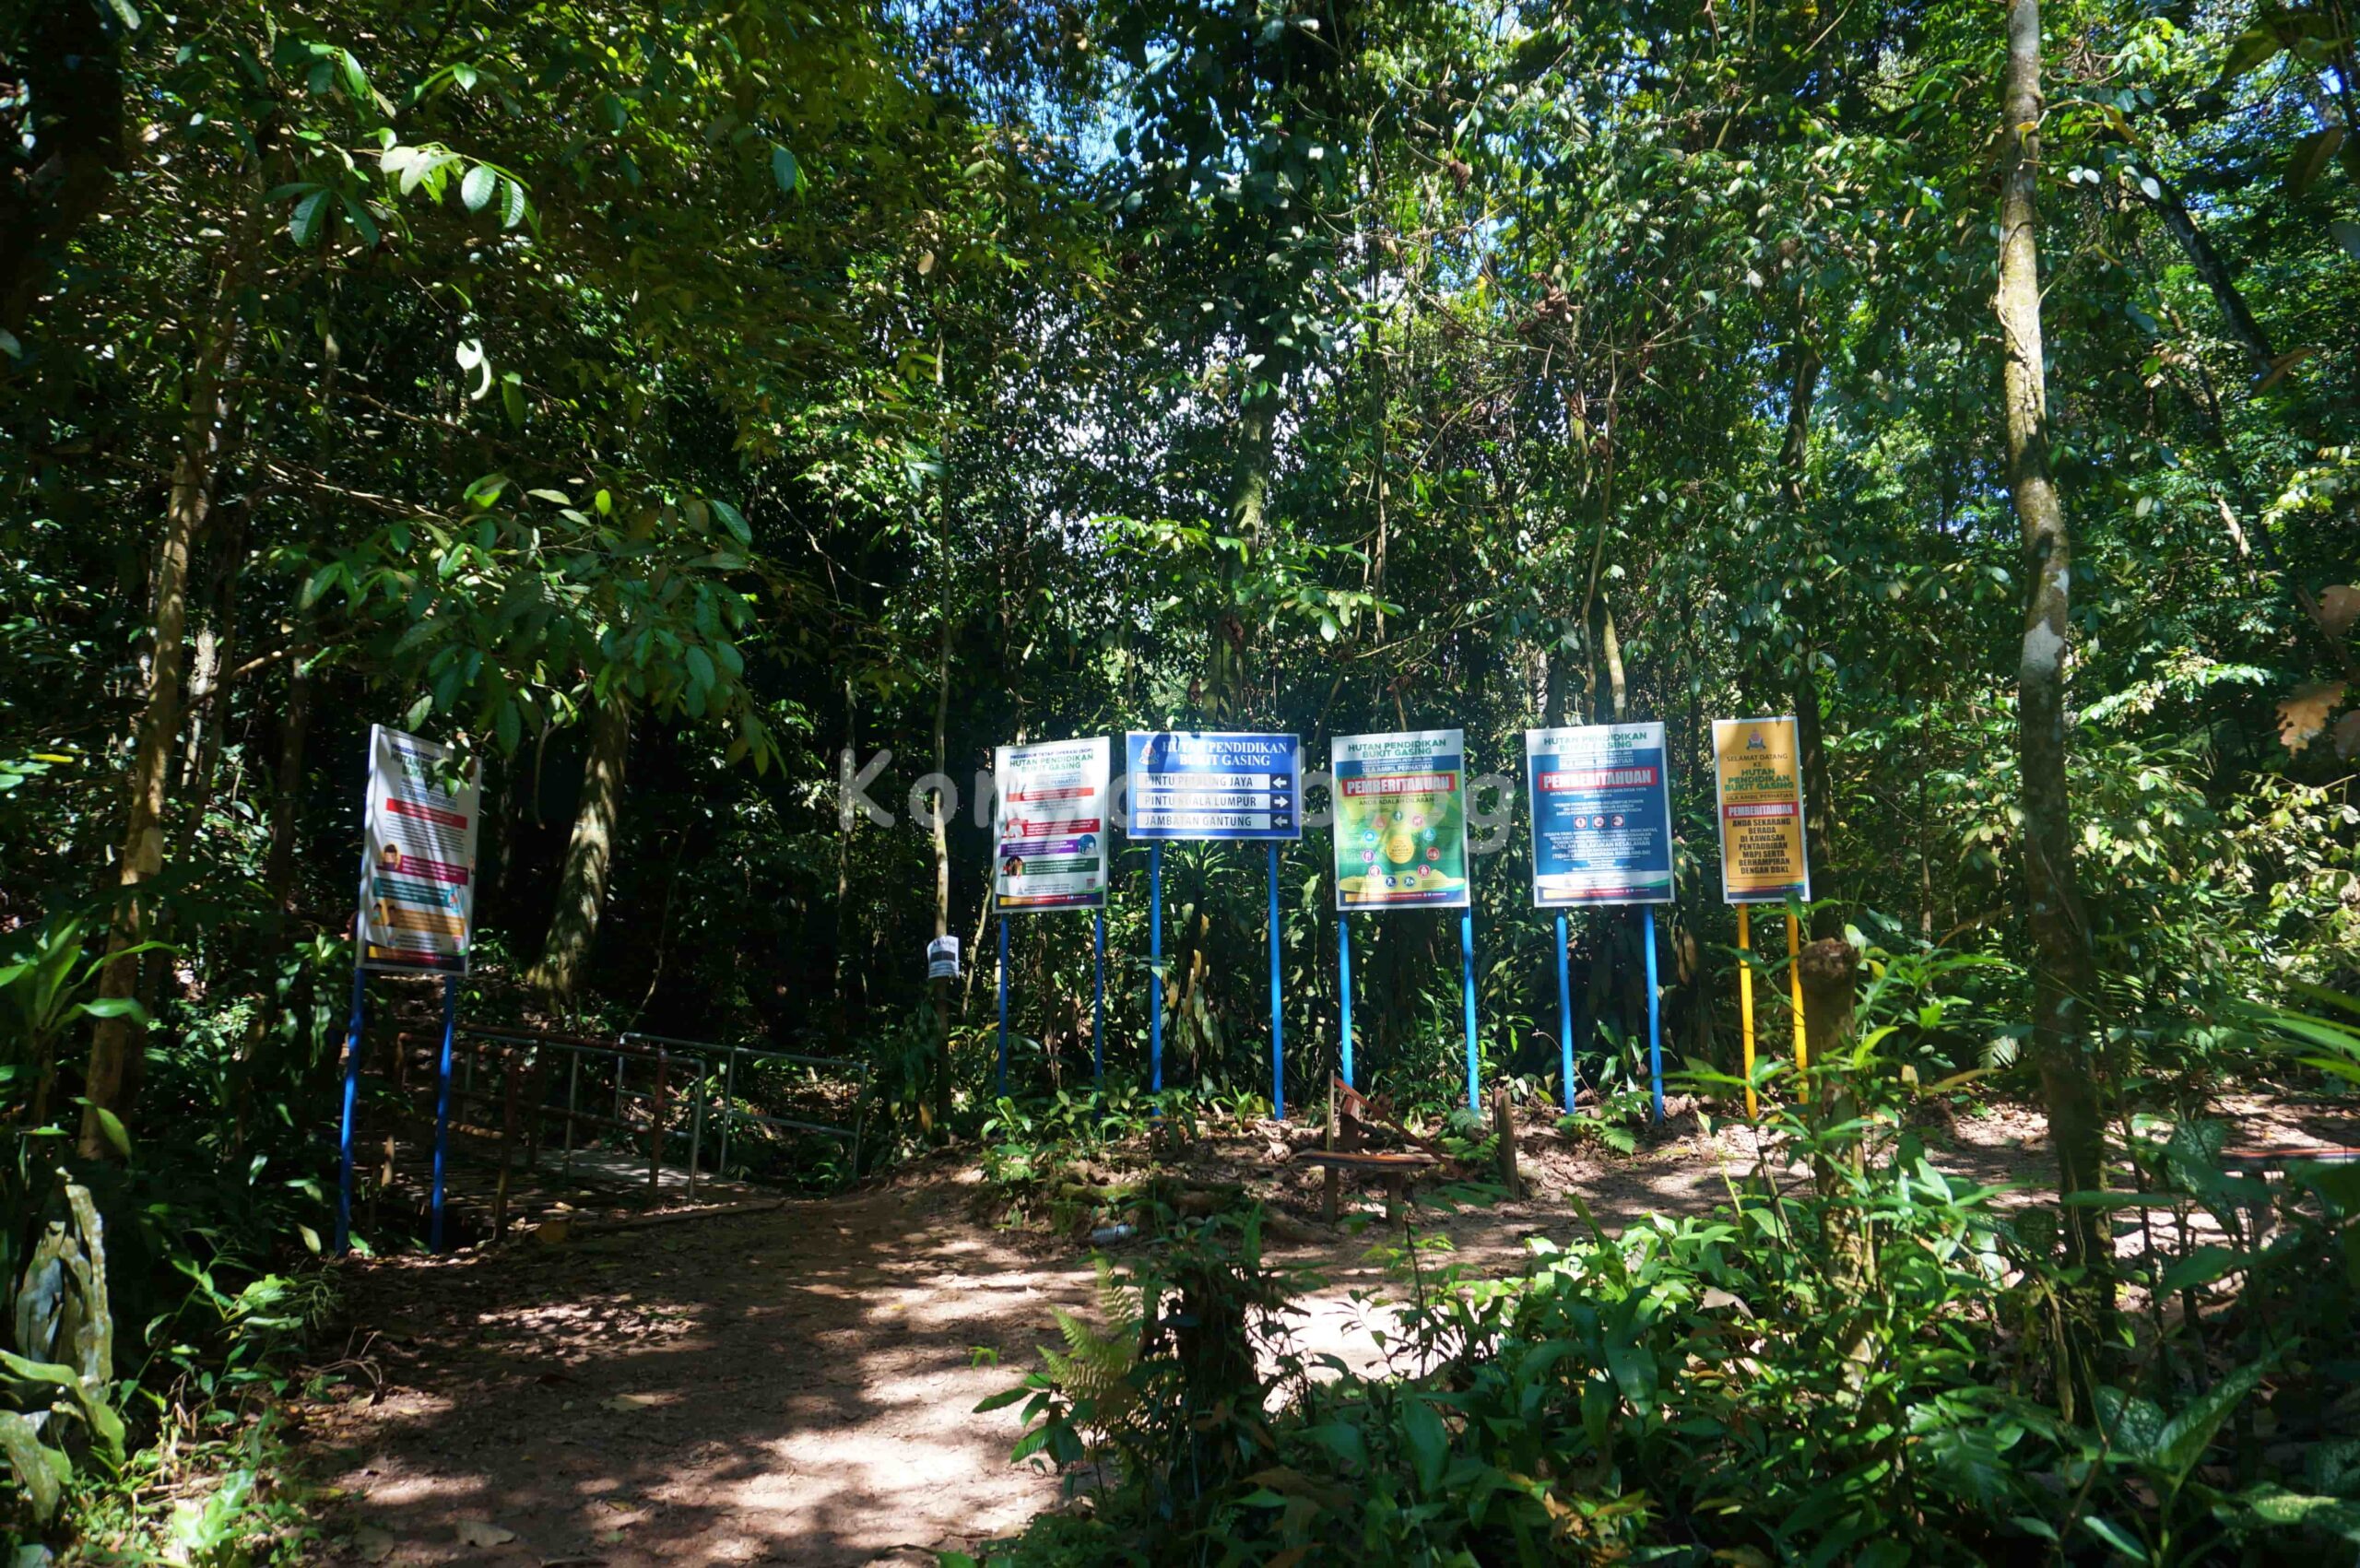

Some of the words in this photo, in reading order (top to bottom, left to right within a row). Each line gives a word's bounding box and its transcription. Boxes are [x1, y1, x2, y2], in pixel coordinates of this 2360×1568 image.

[1348, 743, 1382, 752] HUTAN
[1384, 738, 1446, 749] PENDIDIKAN
[1544, 737, 1579, 746] HUTAN
[1209, 741, 1287, 753] PENDIDIKAN
[1363, 749, 1391, 759] BUKIT
[1394, 748, 1433, 756] GASING
[1727, 754, 1758, 762] SELAMAT
[1009, 757, 1038, 767] HUTAN
[1040, 753, 1094, 764] PENDIDIKAN
[1221, 754, 1270, 766] GASING
[1049, 761, 1081, 771] GASING
[1397, 763, 1434, 772] PERHATIAN
[1741, 768, 1776, 776] HUTAN
[1145, 775, 1175, 786] PINTU
[1230, 776, 1253, 786] JAYA
[1543, 770, 1651, 789] PEMBERITAHUAN
[1728, 774, 1790, 784] PENDIDIKAN
[1347, 775, 1449, 795] PEMBERITAHUAN
[1725, 783, 1754, 792] BUKIT
[1756, 782, 1794, 790] GASING
[1145, 796, 1175, 807] PINTU
[1178, 796, 1211, 807] KUALA
[1214, 796, 1257, 807] LUMPUR
[1378, 796, 1405, 805] ADALAH
[1405, 796, 1439, 804] DILARANG
[1728, 804, 1793, 817] PEMBERITAHUAN
[1145, 815, 1199, 826] JAMBATAN
[1202, 816, 1252, 827] GANTUNG
[1733, 819, 1752, 827] ANDA
[1753, 818, 1791, 826] SEKARANG
[1750, 833, 1786, 842] KAWASAN
[1739, 842, 1788, 851] PENTADBIRAN
[1739, 857, 1790, 867] BERHAMPIRAN
[1740, 867, 1769, 875] DENGAN
